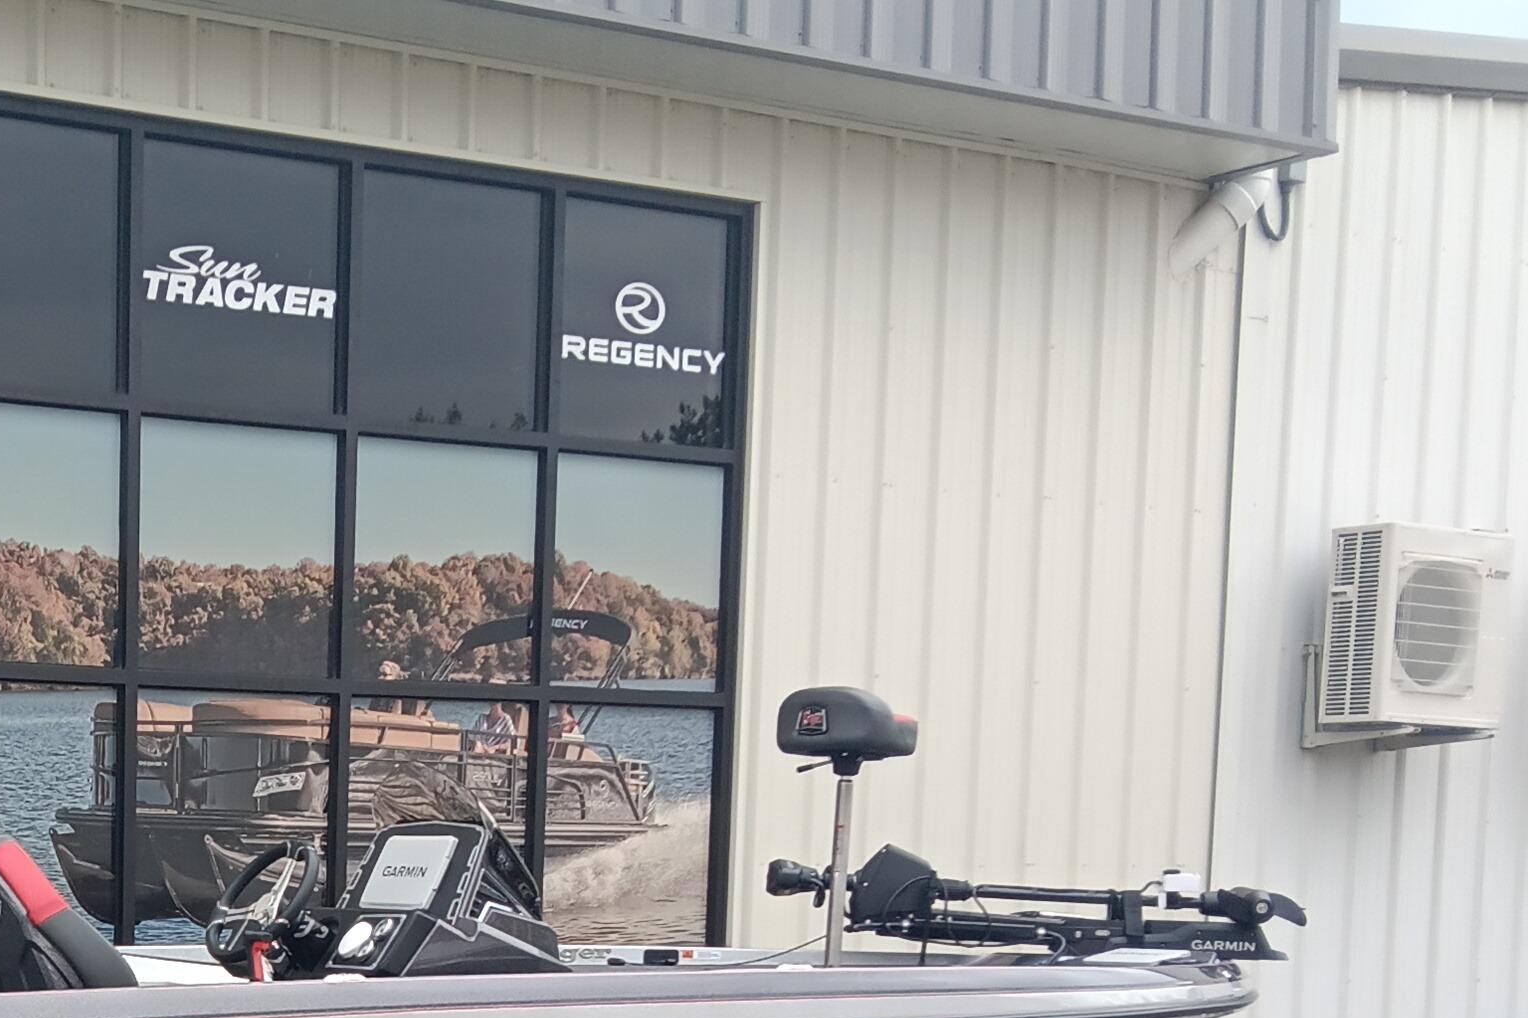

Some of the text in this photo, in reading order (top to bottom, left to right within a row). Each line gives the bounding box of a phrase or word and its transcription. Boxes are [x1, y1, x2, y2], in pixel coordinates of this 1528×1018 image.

[155, 245, 262, 282] Sun
[142, 269, 337, 319] TRACKER
[561, 334, 726, 375] REGENCY
[381, 865, 429, 878] GARMIN
[1190, 939, 1257, 952] GARMIN
